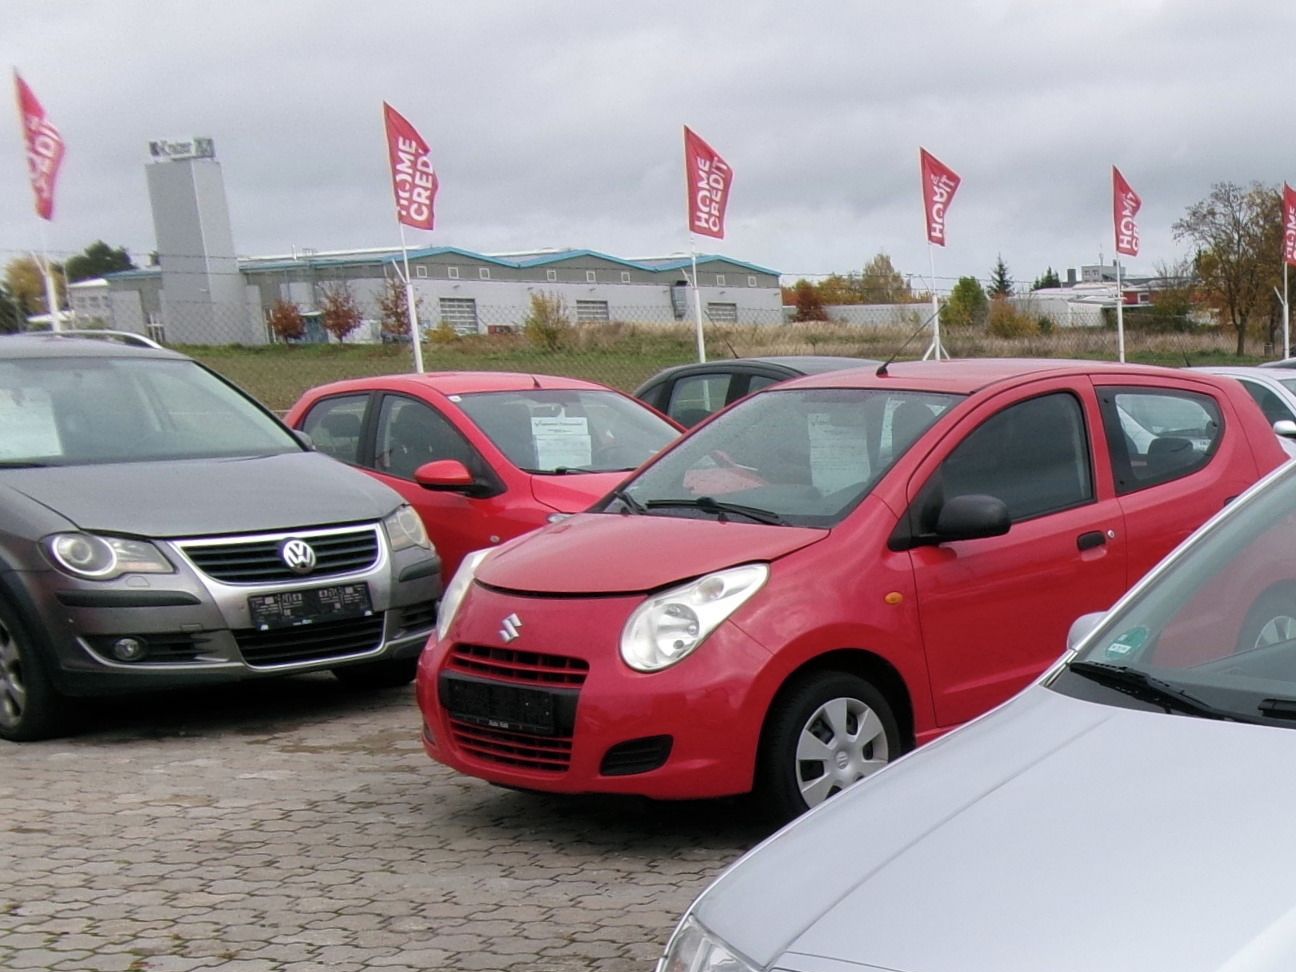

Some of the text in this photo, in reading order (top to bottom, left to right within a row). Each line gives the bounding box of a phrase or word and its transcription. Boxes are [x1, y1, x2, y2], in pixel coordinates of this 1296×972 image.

[409, 148, 433, 221] CRED
[695, 156, 711, 229] HOME
[708, 157, 728, 232] CREDIT
